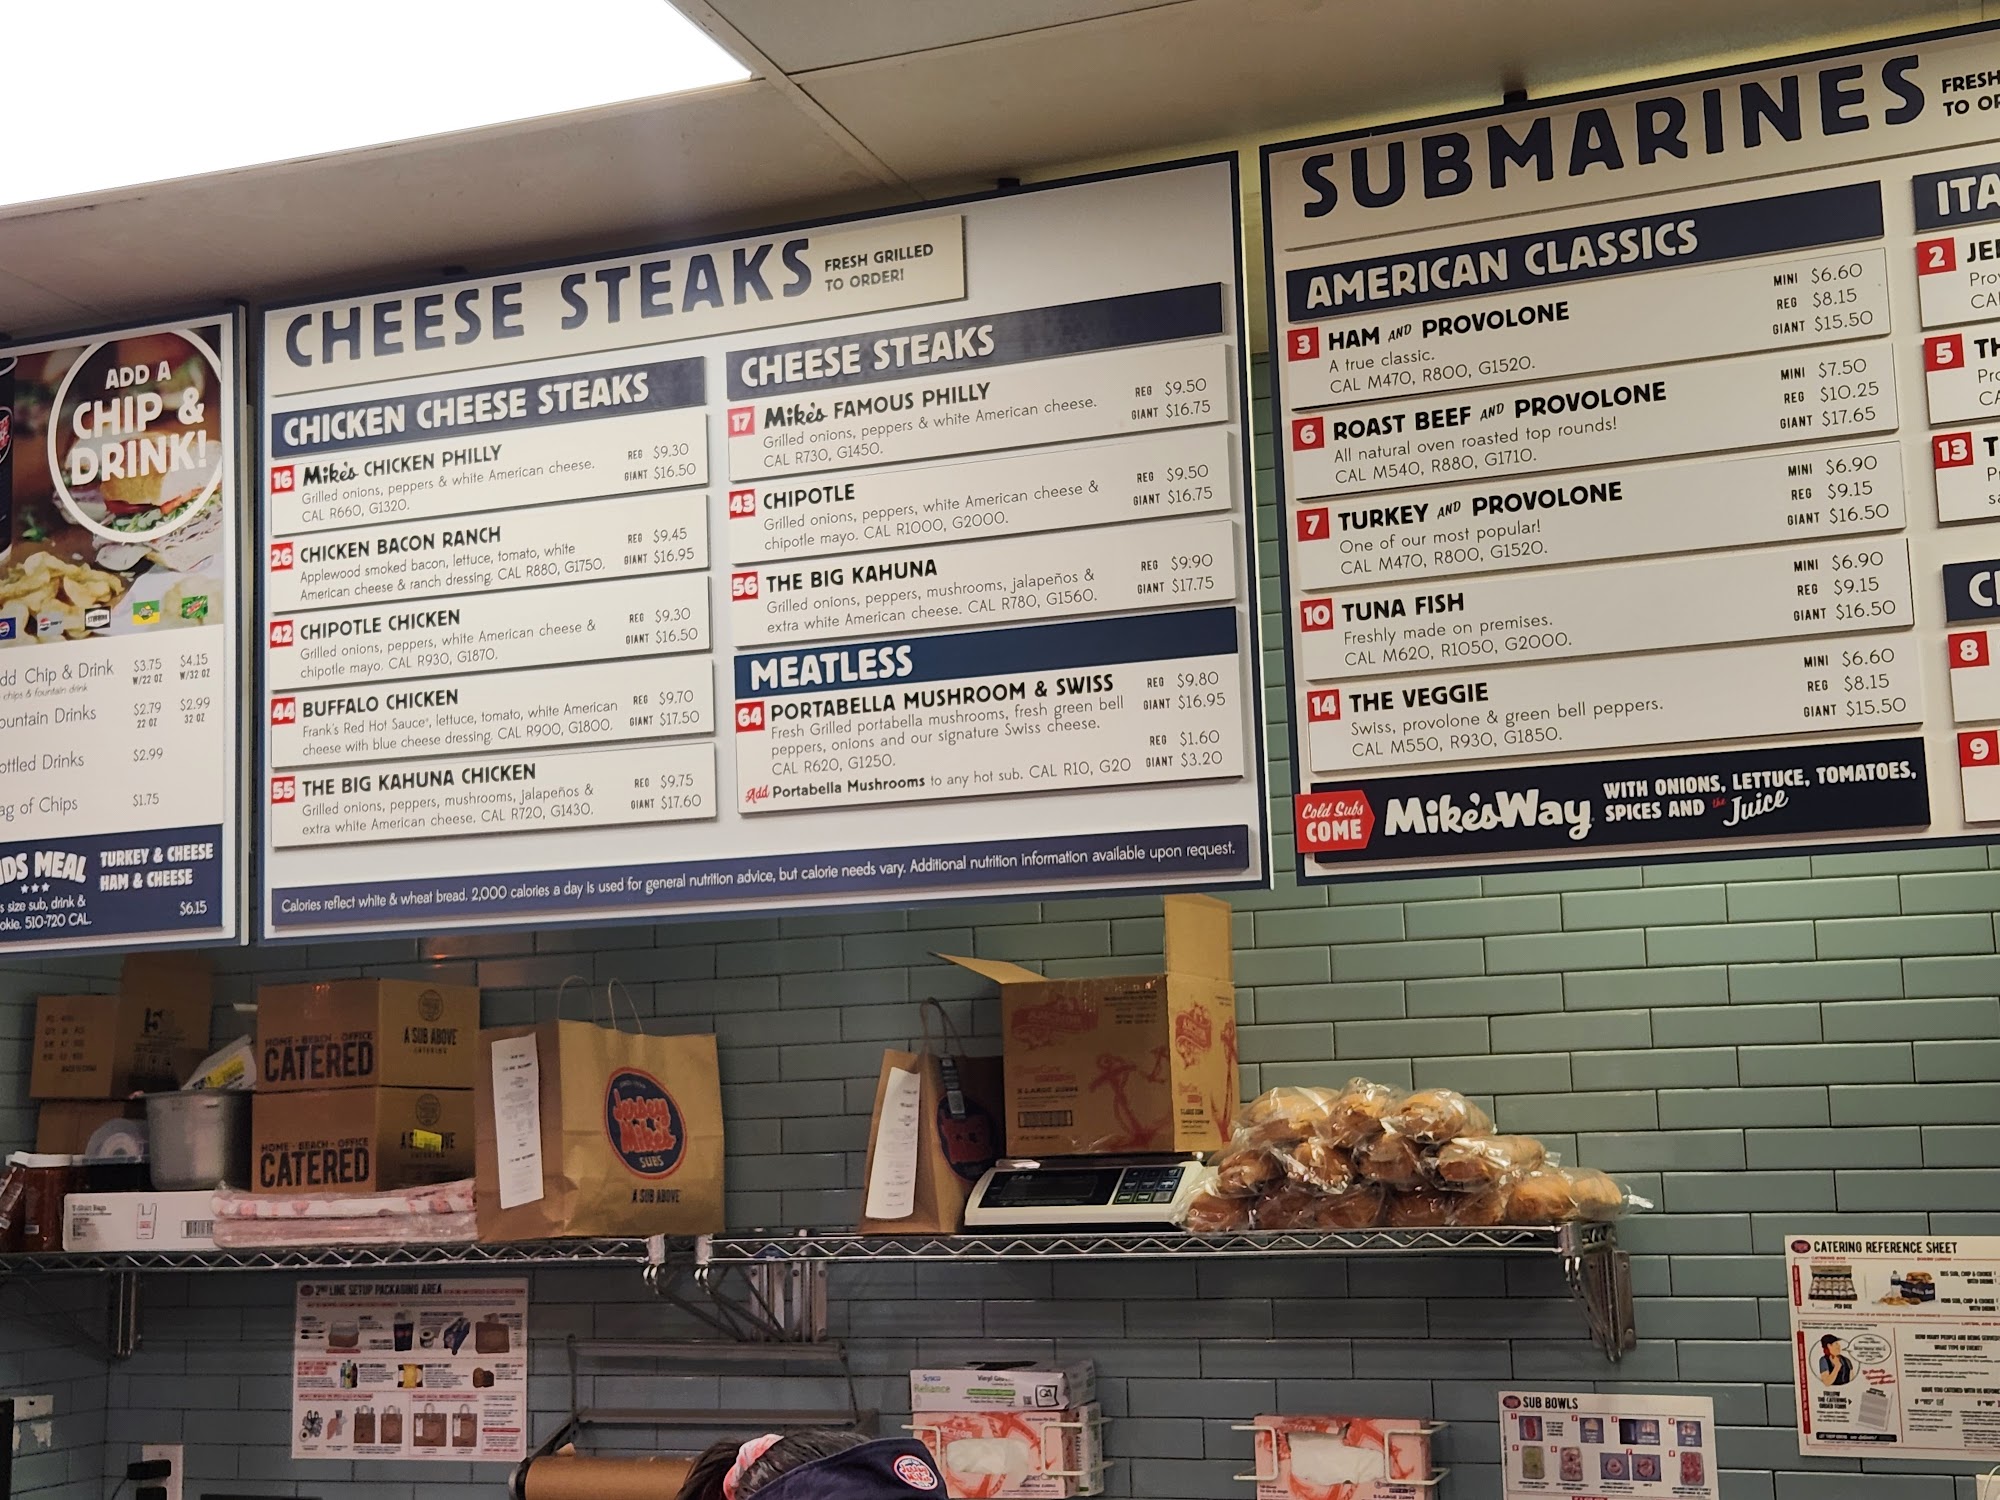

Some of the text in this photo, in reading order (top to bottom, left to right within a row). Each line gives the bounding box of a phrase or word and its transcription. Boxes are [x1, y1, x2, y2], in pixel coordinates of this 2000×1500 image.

[1302, 55, 1924, 218] SUBMARINES
[825, 244, 933, 272] FRESH GRILLED
[1307, 220, 1697, 309] AMERICAN CLASSICS
[1929, 246, 1945, 267] 2
[825, 268, 903, 291] TO ORDER!
[1774, 263, 1862, 286] MINI $6.60
[286, 238, 811, 366] CHEESE STEAKS
[1777, 288, 1857, 310] REG $8.15
[1297, 301, 1569, 354] 3 HAM AND PROVOLONE
[1773, 311, 1873, 335] GIANT $15.50
[742, 325, 994, 386] CHEESE STEAKS
[1329, 350, 1435, 373] A true classic.
[1937, 342, 1953, 363] 5
[105, 361, 171, 389] ADD A
[1135, 378, 1206, 397] REG $9.50
[1330, 356, 1535, 393] CAL M470, R800, G1520.
[72, 387, 204, 440] CHIP &
[284, 372, 648, 446] CHICKEN CHEESE STEAKS
[732, 382, 990, 431] 17 Mike's FAMOUS PHILLY
[1301, 381, 1666, 444] 6 ROAST BEEF AND PROVOLONE
[72, 430, 206, 486] DRINK!
[1939, 439, 1967, 461] 13
[274, 444, 502, 489] 16 Mike's CHICKEN PHILLY
[730, 484, 854, 514] 43 CHIPOTLE
[1306, 481, 1622, 534] 7 TURKEY AND PROVOLONE
[271, 526, 500, 567] 26 CHICKEN BACON RANCH
[732, 559, 937, 597] 56 THE BIG KAHUNA
[1304, 593, 1464, 625] 10 TUNA FISH
[271, 609, 460, 642] 42 CHIPOTLE CHICKEN
[1960, 640, 1978, 661] 8
[25, 653, 208, 686] Chip & Drink $3.75 $4.15
[751, 645, 912, 690] MEATLESS
[55, 697, 210, 723] Drinks $2.79 $2.99
[272, 689, 458, 719] 44 BUFFALO CHICKEN
[738, 674, 1113, 726] 64 PORTABELLA MUSHROOM & SWISS
[1312, 682, 1488, 716] 14 THE VEGGIE
[43, 748, 163, 769] Drinks $2.99
[1970, 738, 1989, 760] 9
[272, 763, 535, 799] 55 THE BIG KAHUNA CHICKEN
[746, 785, 769, 803] Add
[1603, 761, 1916, 799] WITH ONIONS, LETTUCE, TOMATOES,
[20, 793, 159, 815] of Chips $1.75
[1302, 801, 1363, 819] Cold Subs
[1606, 802, 1661, 821] SPICES
[1669, 799, 1705, 817] AND
[1721, 786, 1788, 826] Juice
[1307, 819, 1362, 842] COME
[35, 851, 86, 883] MEAL
[100, 843, 213, 867] TURKEY & CHEESE
[100, 869, 192, 891] HAM & CHEESE
[180, 901, 207, 916] $6.15
[404, 1027, 457, 1045] A SUB ABOVE
[264, 1041, 374, 1082] CATERED
[261, 1142, 288, 1152] HOME
[338, 1138, 368, 1147] OFFICE
[260, 1148, 370, 1188] CATERED
[640, 1155, 665, 1168] SUBS
[632, 1190, 638, 1203] A
[1814, 1241, 1957, 1253] CATERING REFERENCE SHEET
[348, 1284, 372, 1296] SETUP
[421, 1284, 442, 1294] AREA
[1523, 1396, 1578, 1410] SUB BOWLS
